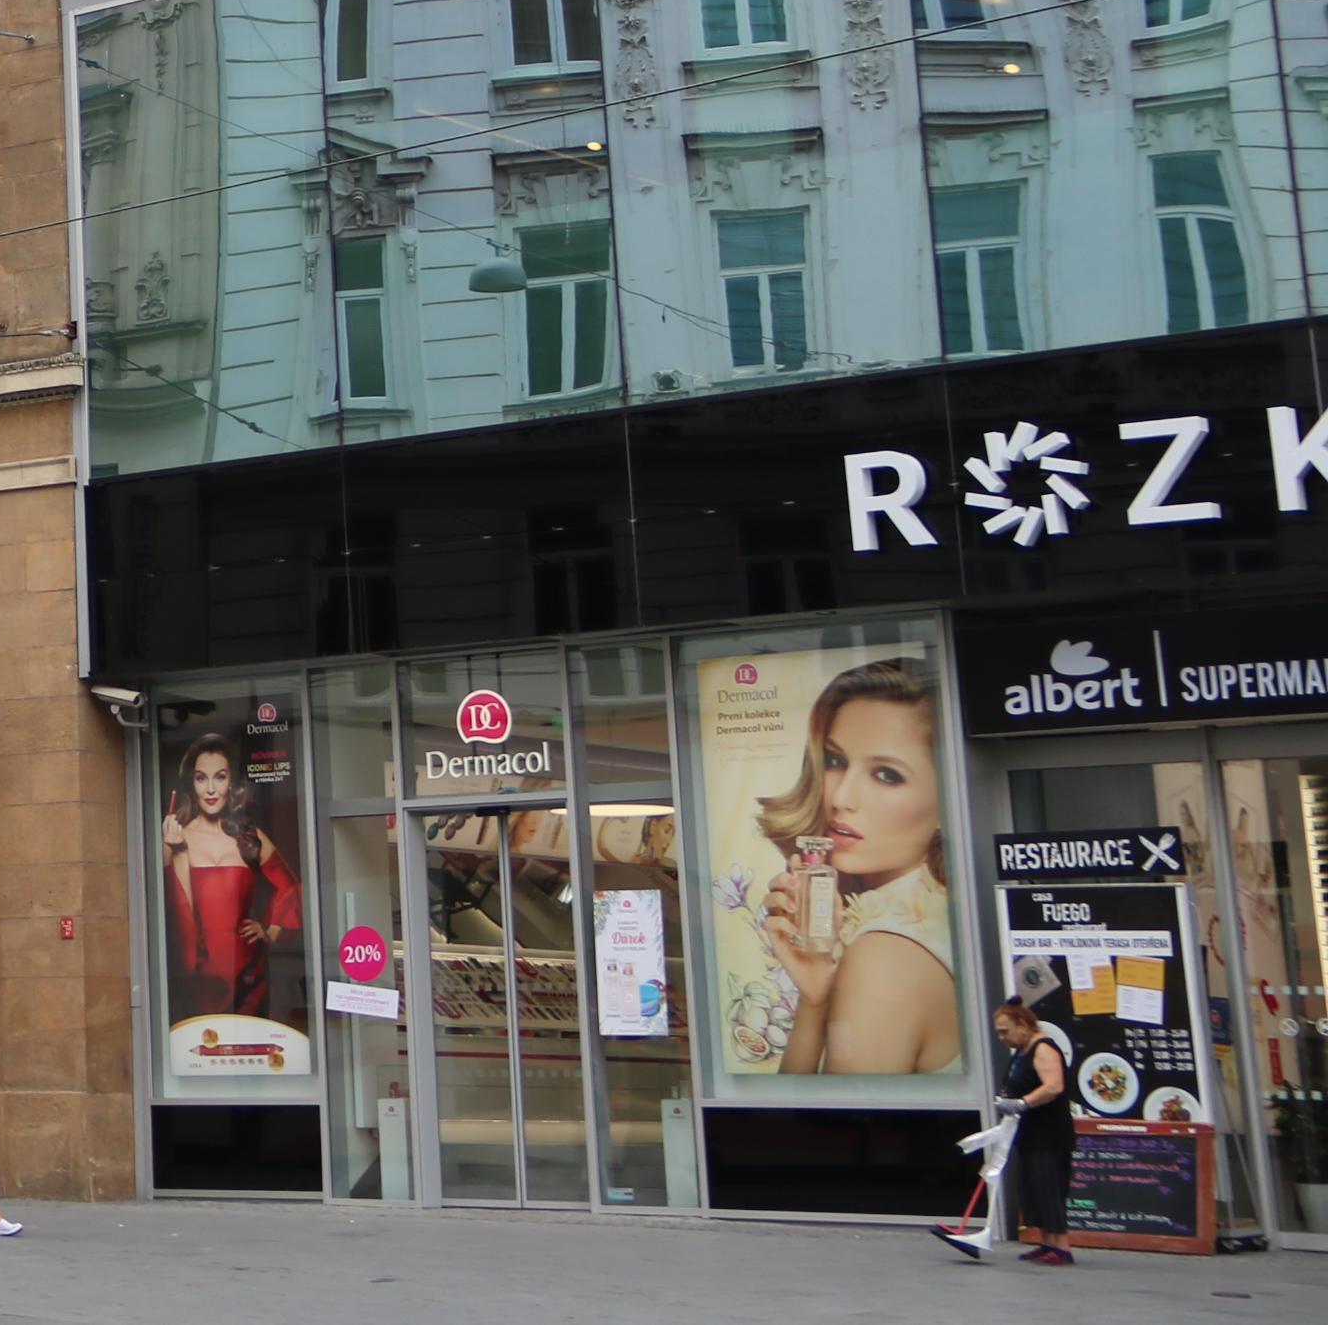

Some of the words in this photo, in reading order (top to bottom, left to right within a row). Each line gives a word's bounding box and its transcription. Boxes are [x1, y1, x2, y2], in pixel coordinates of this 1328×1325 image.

[717, 686, 778, 704] Dermacol
[1004, 668, 1143, 716] albert
[1180, 658, 1328, 703] SUPERMA
[718, 712, 743, 721] První
[745, 709, 781, 719] kolekce
[247, 721, 288, 735] Dermacol
[716, 723, 761, 735] Dermacol
[274, 761, 290, 770] LIPS
[425, 741, 551, 779] Dermacol
[999, 839, 1134, 871] RESTAURACE
[1041, 903, 1091, 923] FUEGO
[344, 944, 381, 963] 20%
